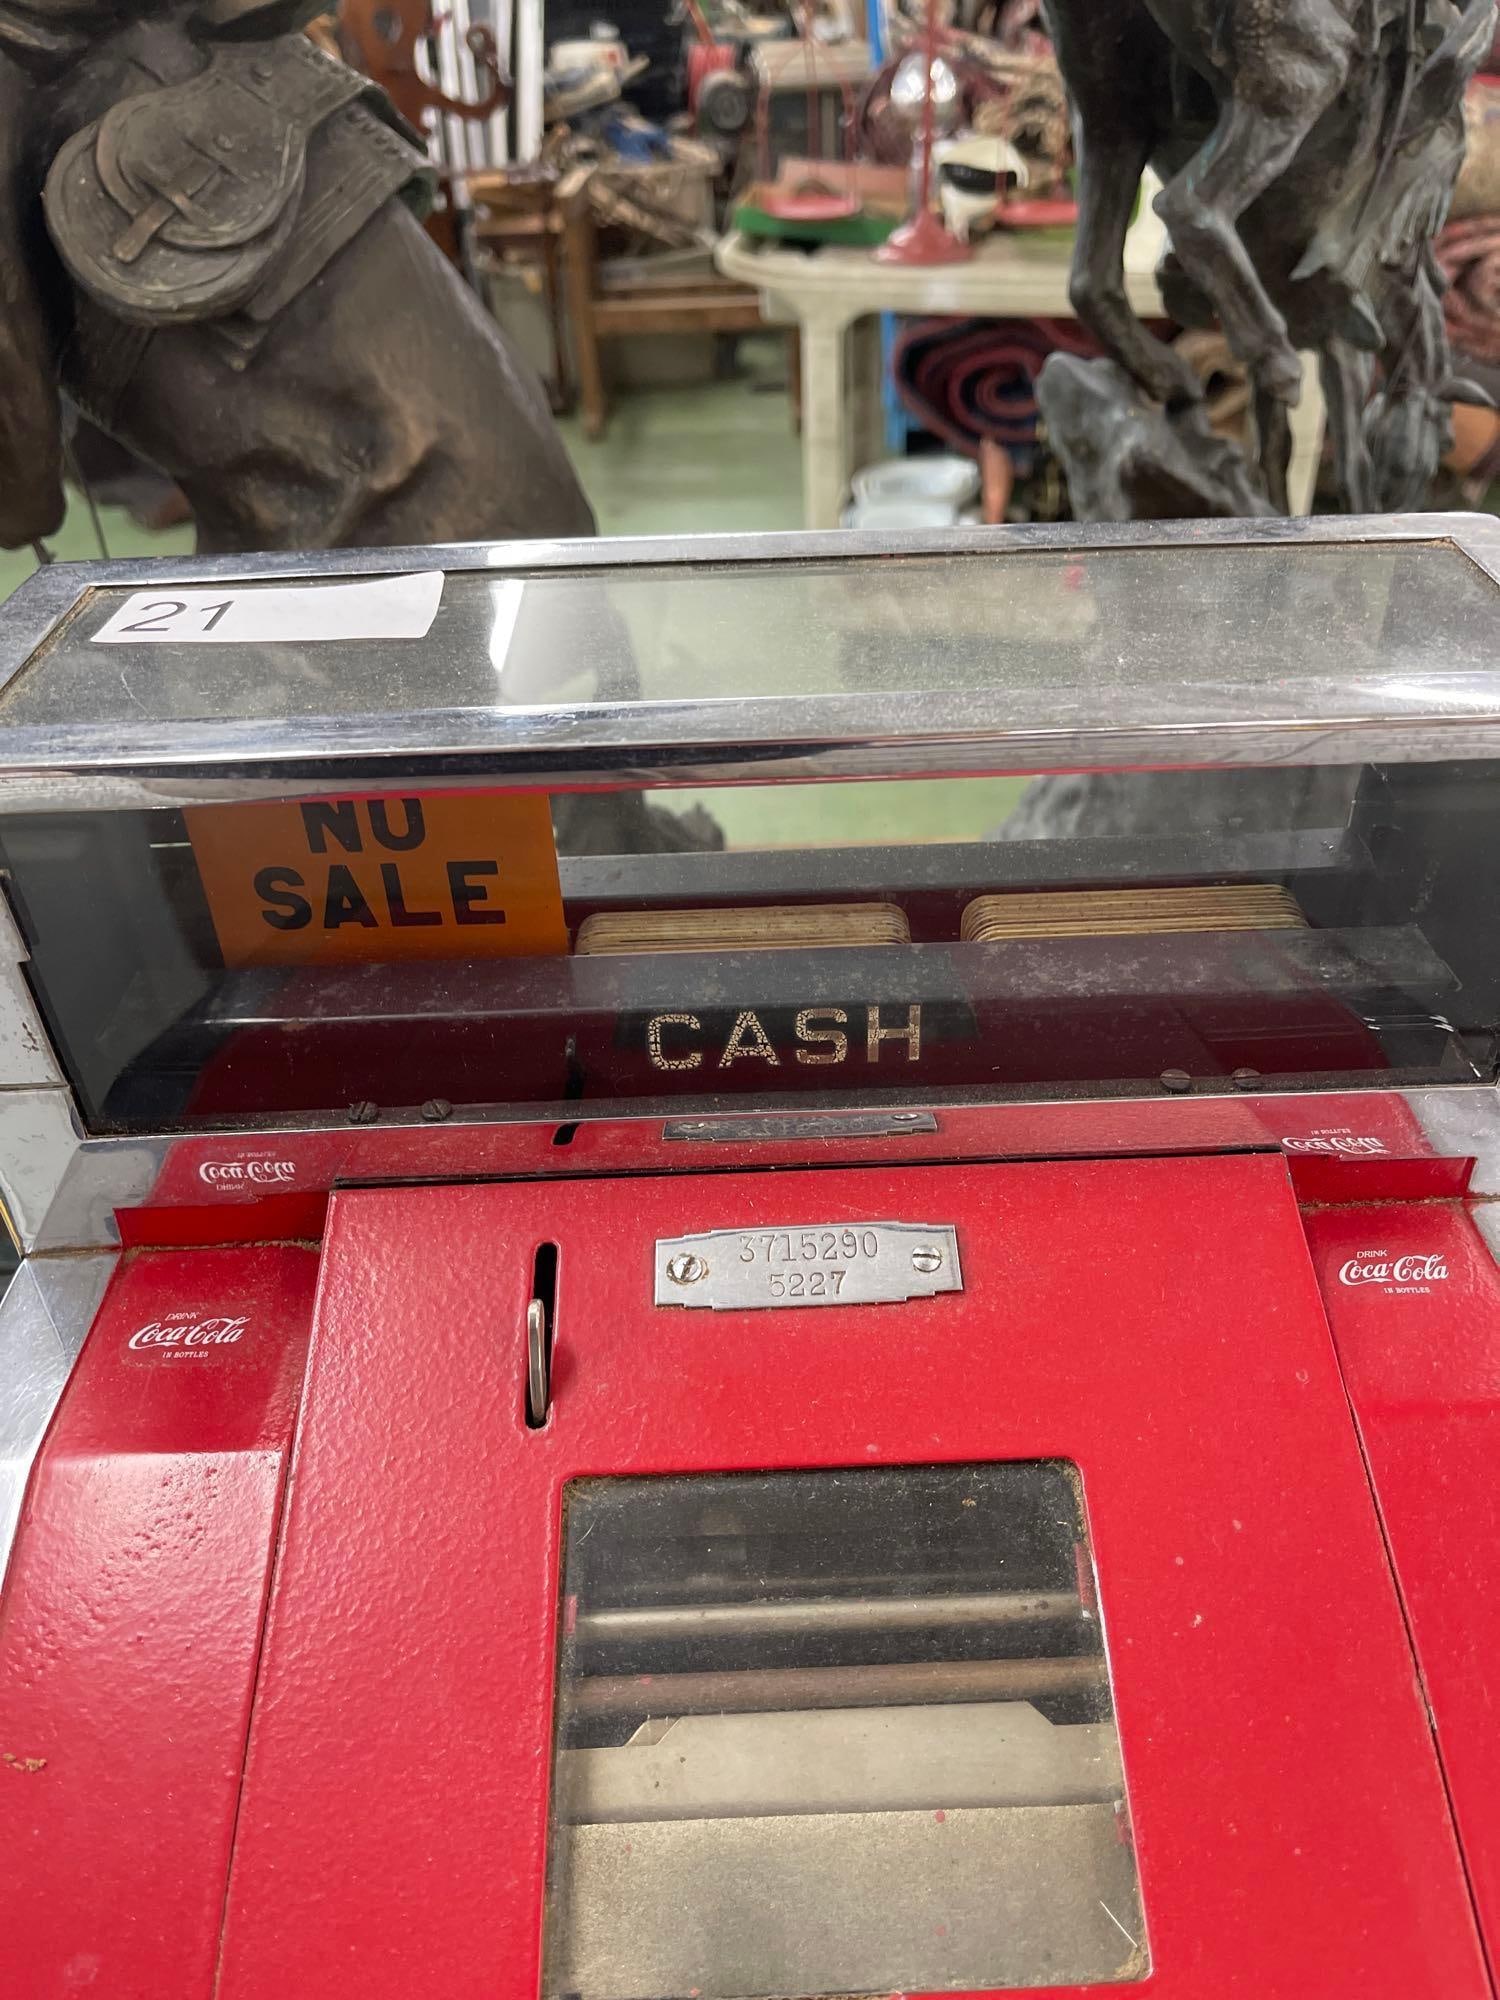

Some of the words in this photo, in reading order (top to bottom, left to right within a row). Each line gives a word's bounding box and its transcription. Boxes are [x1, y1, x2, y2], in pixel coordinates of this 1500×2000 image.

[119, 600, 236, 633] 21
[253, 860, 506, 931] SALE
[648, 1003, 921, 1070] CASH
[739, 1229, 879, 1263] 3715290
[1356, 1249, 1389, 1259] DRINK
[768, 1269, 848, 1298] 5227
[1338, 1253, 1450, 1286] Coca-Cola
[1383, 1286, 1394, 1294] IN
[1395, 1286, 1431, 1294] BOTTLES
[164, 1311, 201, 1321] DRINK
[127, 1316, 252, 1350] Coca-Cola
[173, 1350, 209, 1359] BOTTLES
